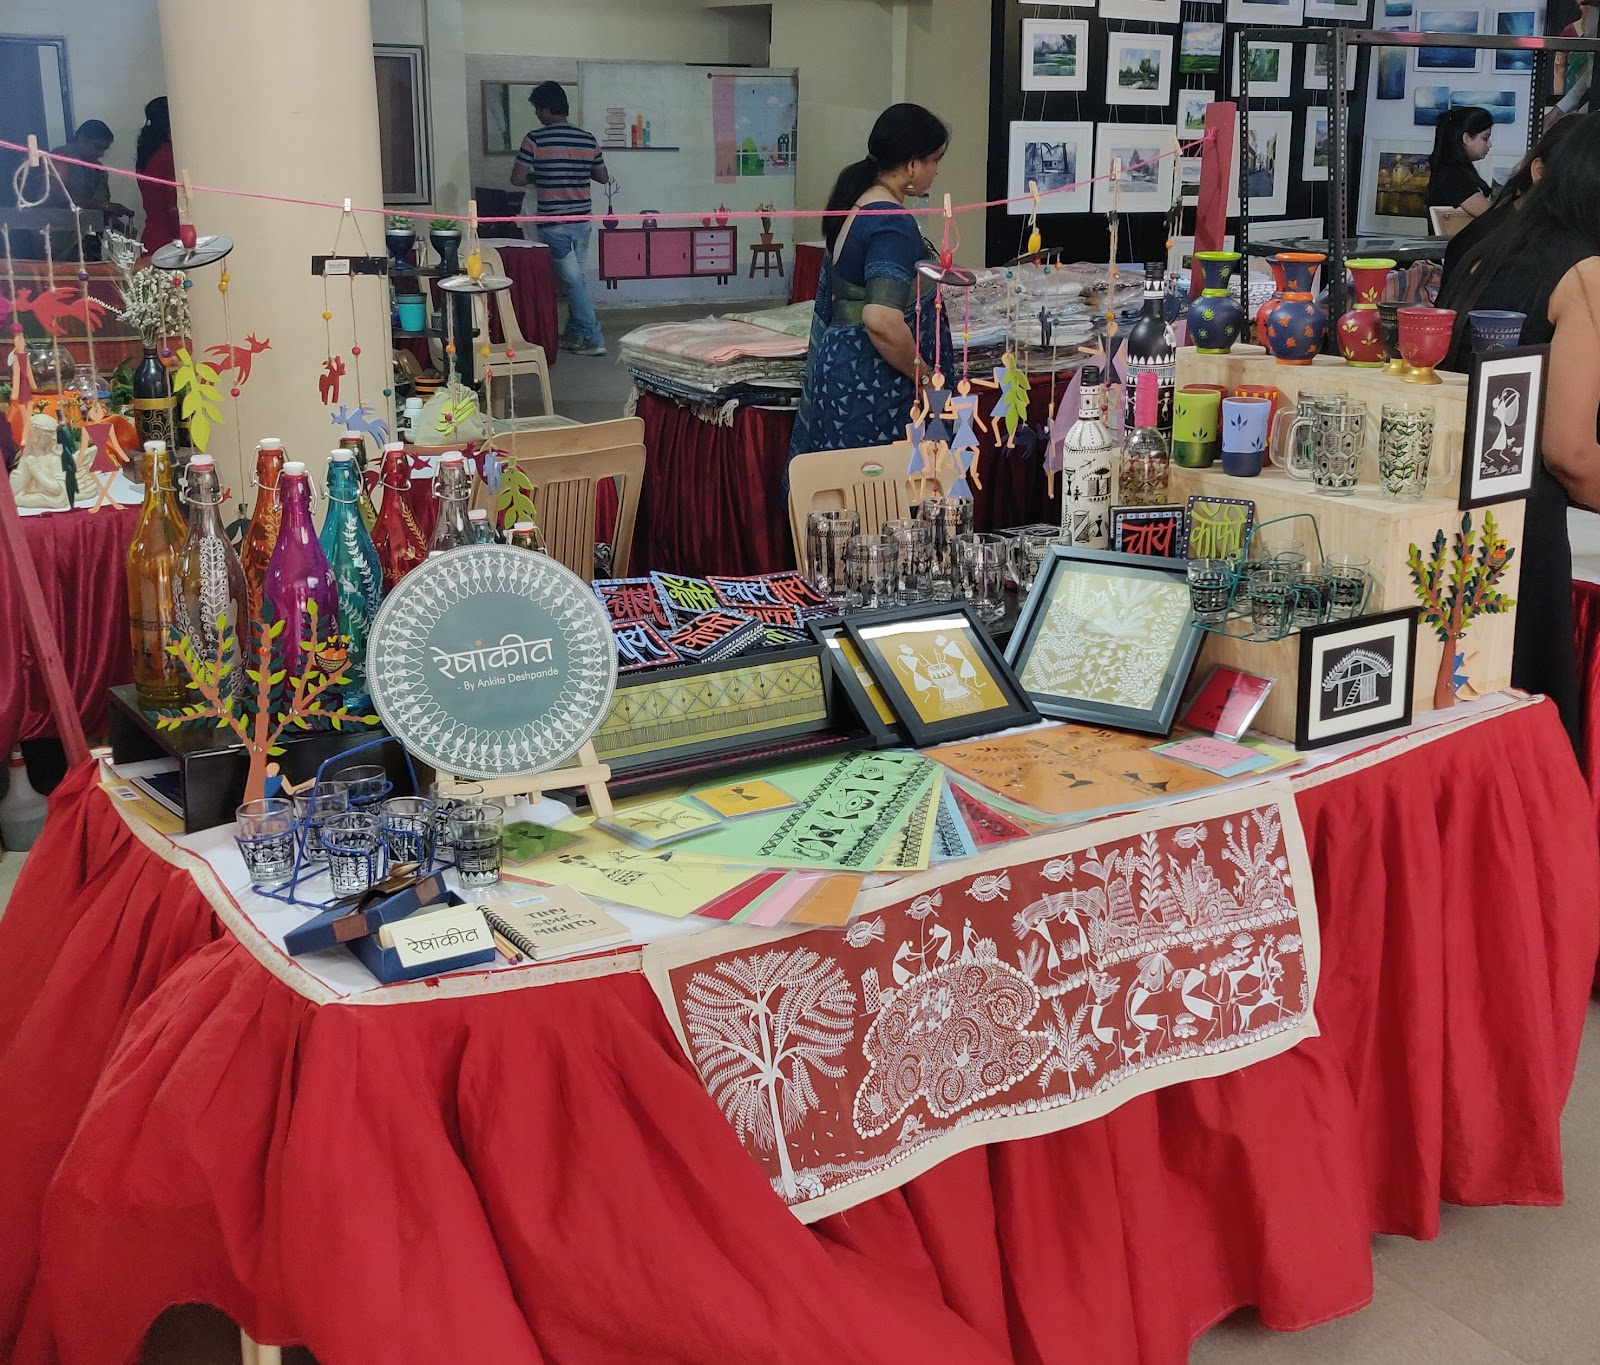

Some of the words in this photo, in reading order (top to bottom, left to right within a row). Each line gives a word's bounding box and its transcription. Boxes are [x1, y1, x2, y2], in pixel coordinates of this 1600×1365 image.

[1122, 517, 1177, 557] चाय
[429, 634, 553, 679] रेषांकीत
[464, 681, 475, 691] By
[477, 677, 506, 688] Ankita
[508, 667, 559, 683] Deshpande
[404, 927, 479, 953] रेषांकीत
